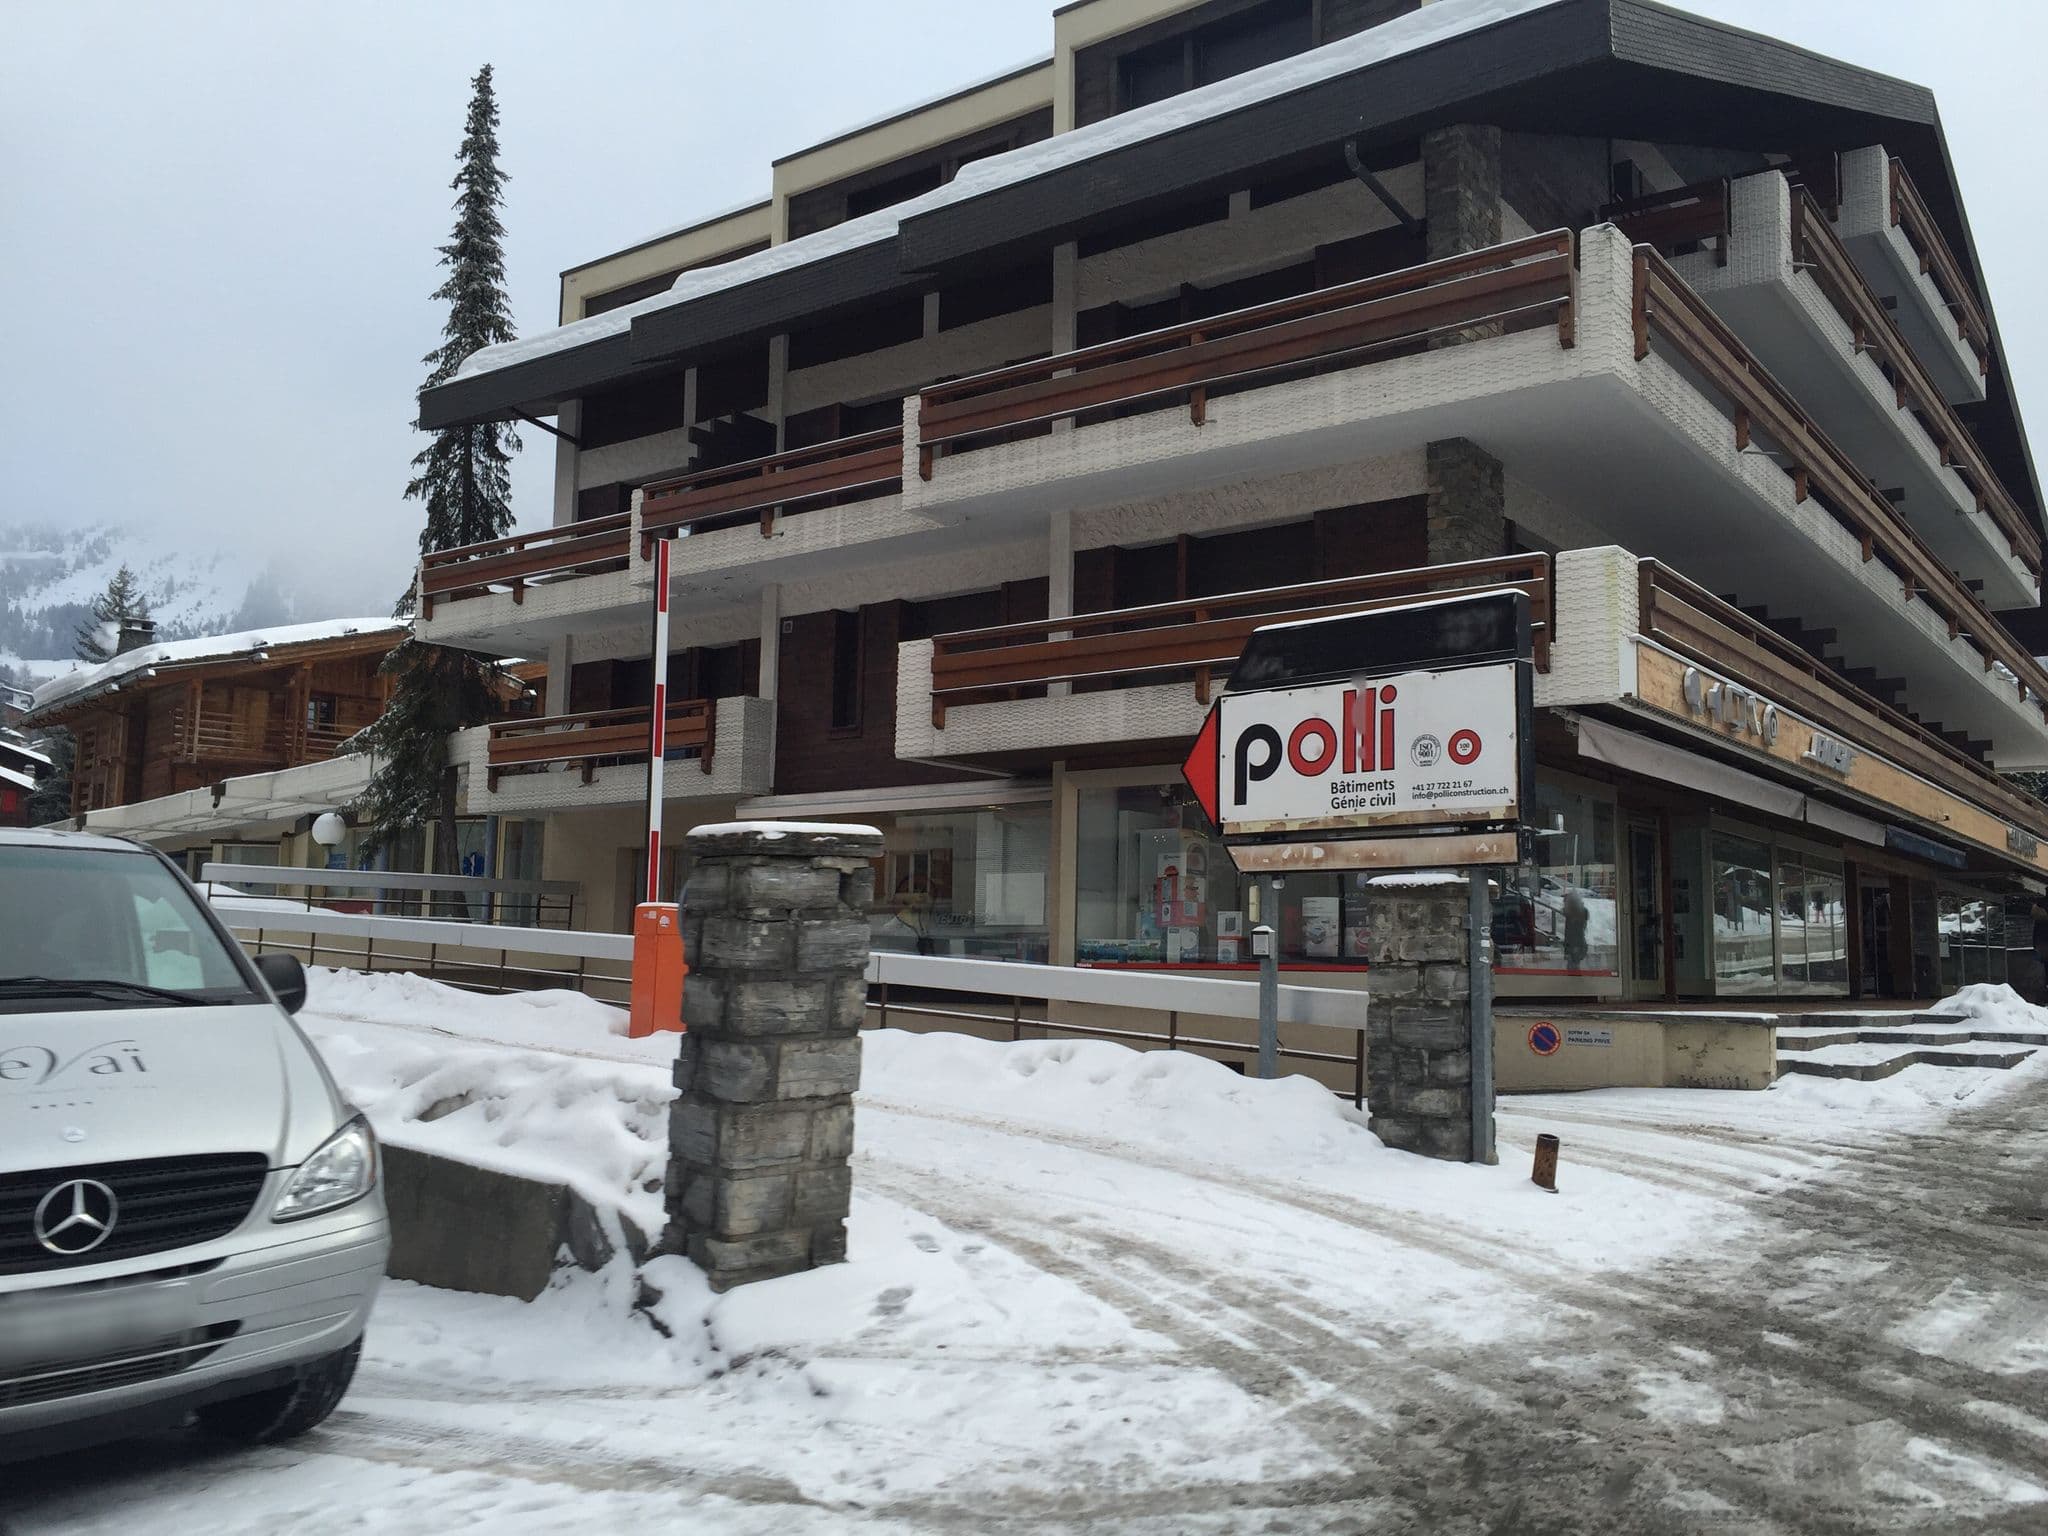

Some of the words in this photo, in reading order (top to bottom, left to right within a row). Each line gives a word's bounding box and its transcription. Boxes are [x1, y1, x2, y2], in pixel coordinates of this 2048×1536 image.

[1234, 684, 1398, 806] polli
[1418, 749, 1433, 758] 9001
[1330, 779, 1395, 794] Bâtiments
[1437, 782, 1450, 790] 722
[1463, 780, 1472, 788] 67
[1412, 786, 1509, 800] info@polliconstruction.ch
[1331, 795, 1366, 809] Génie
[1369, 792, 1396, 807] civil
